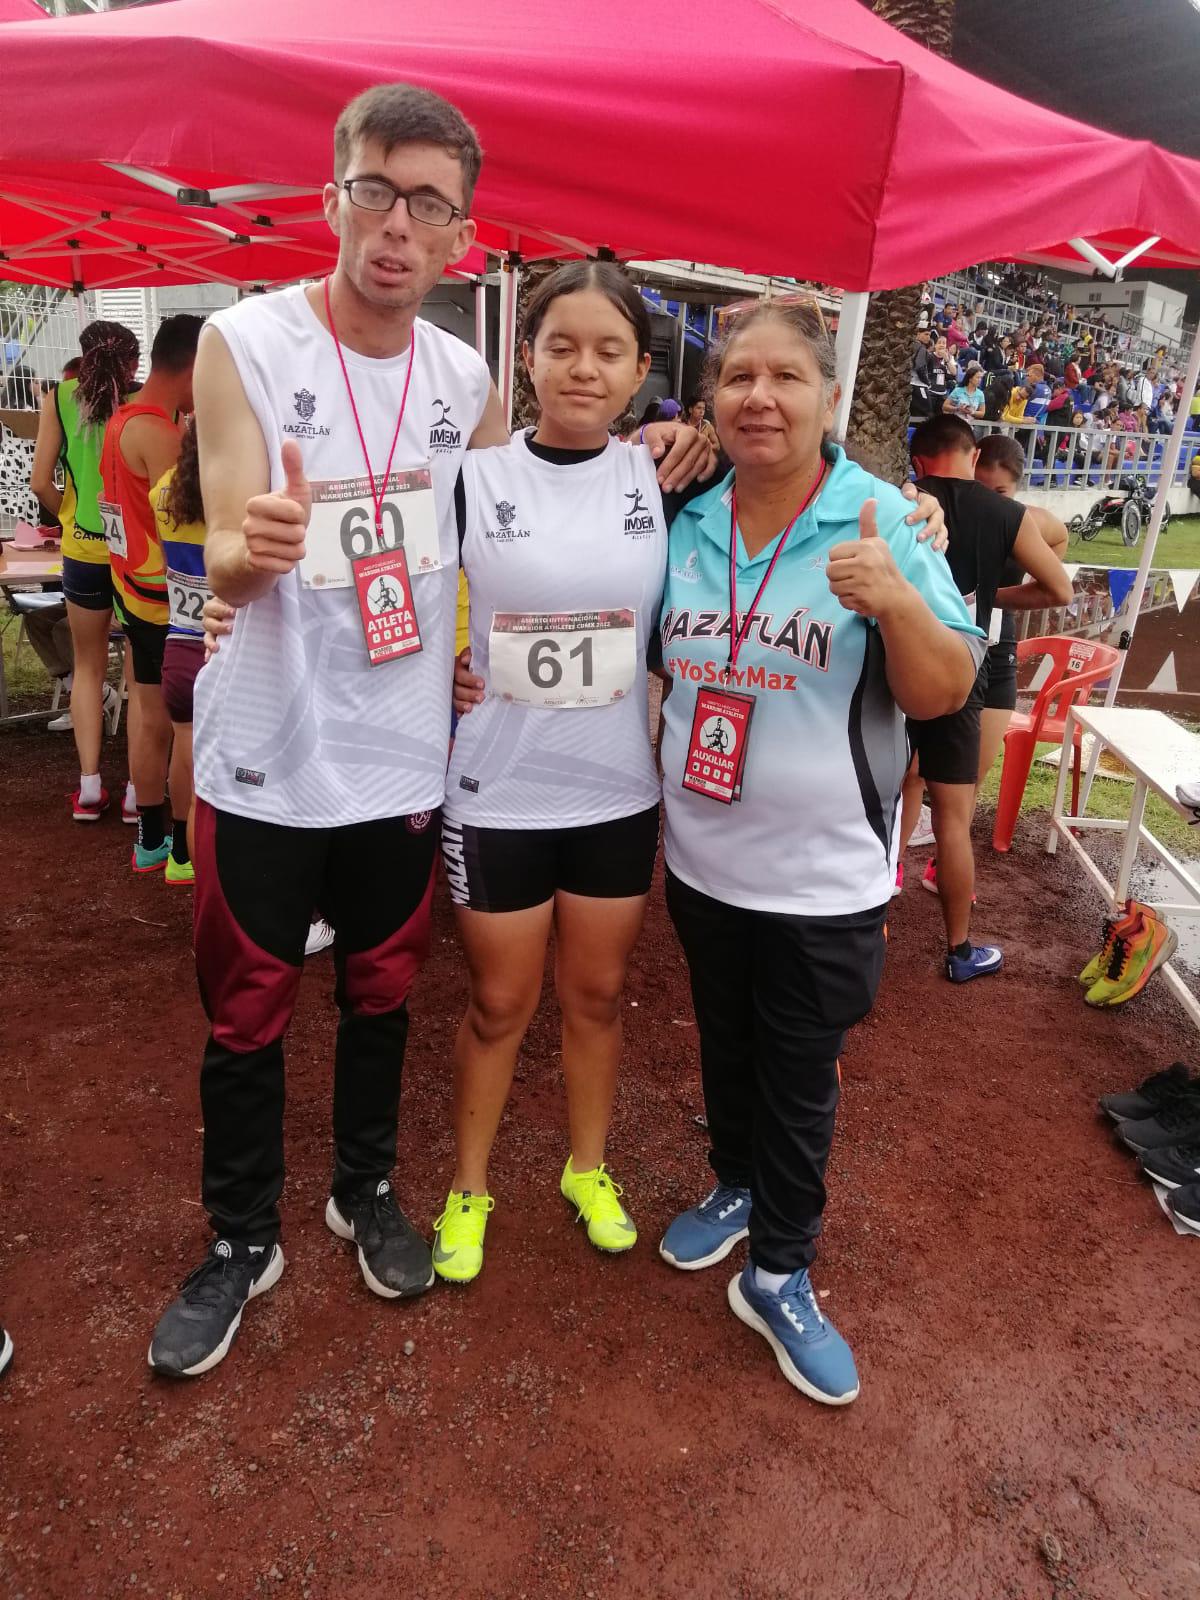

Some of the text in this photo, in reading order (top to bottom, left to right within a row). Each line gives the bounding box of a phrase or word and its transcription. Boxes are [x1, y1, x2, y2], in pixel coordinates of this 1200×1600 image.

[340, 502, 404, 560] 60
[174, 587, 214, 621] 22
[368, 610, 413, 633] ATLETA
[528, 637, 592, 688] 61
[1071, 660, 1081, 669] 16
[692, 749, 734, 771] AUXILIAR
